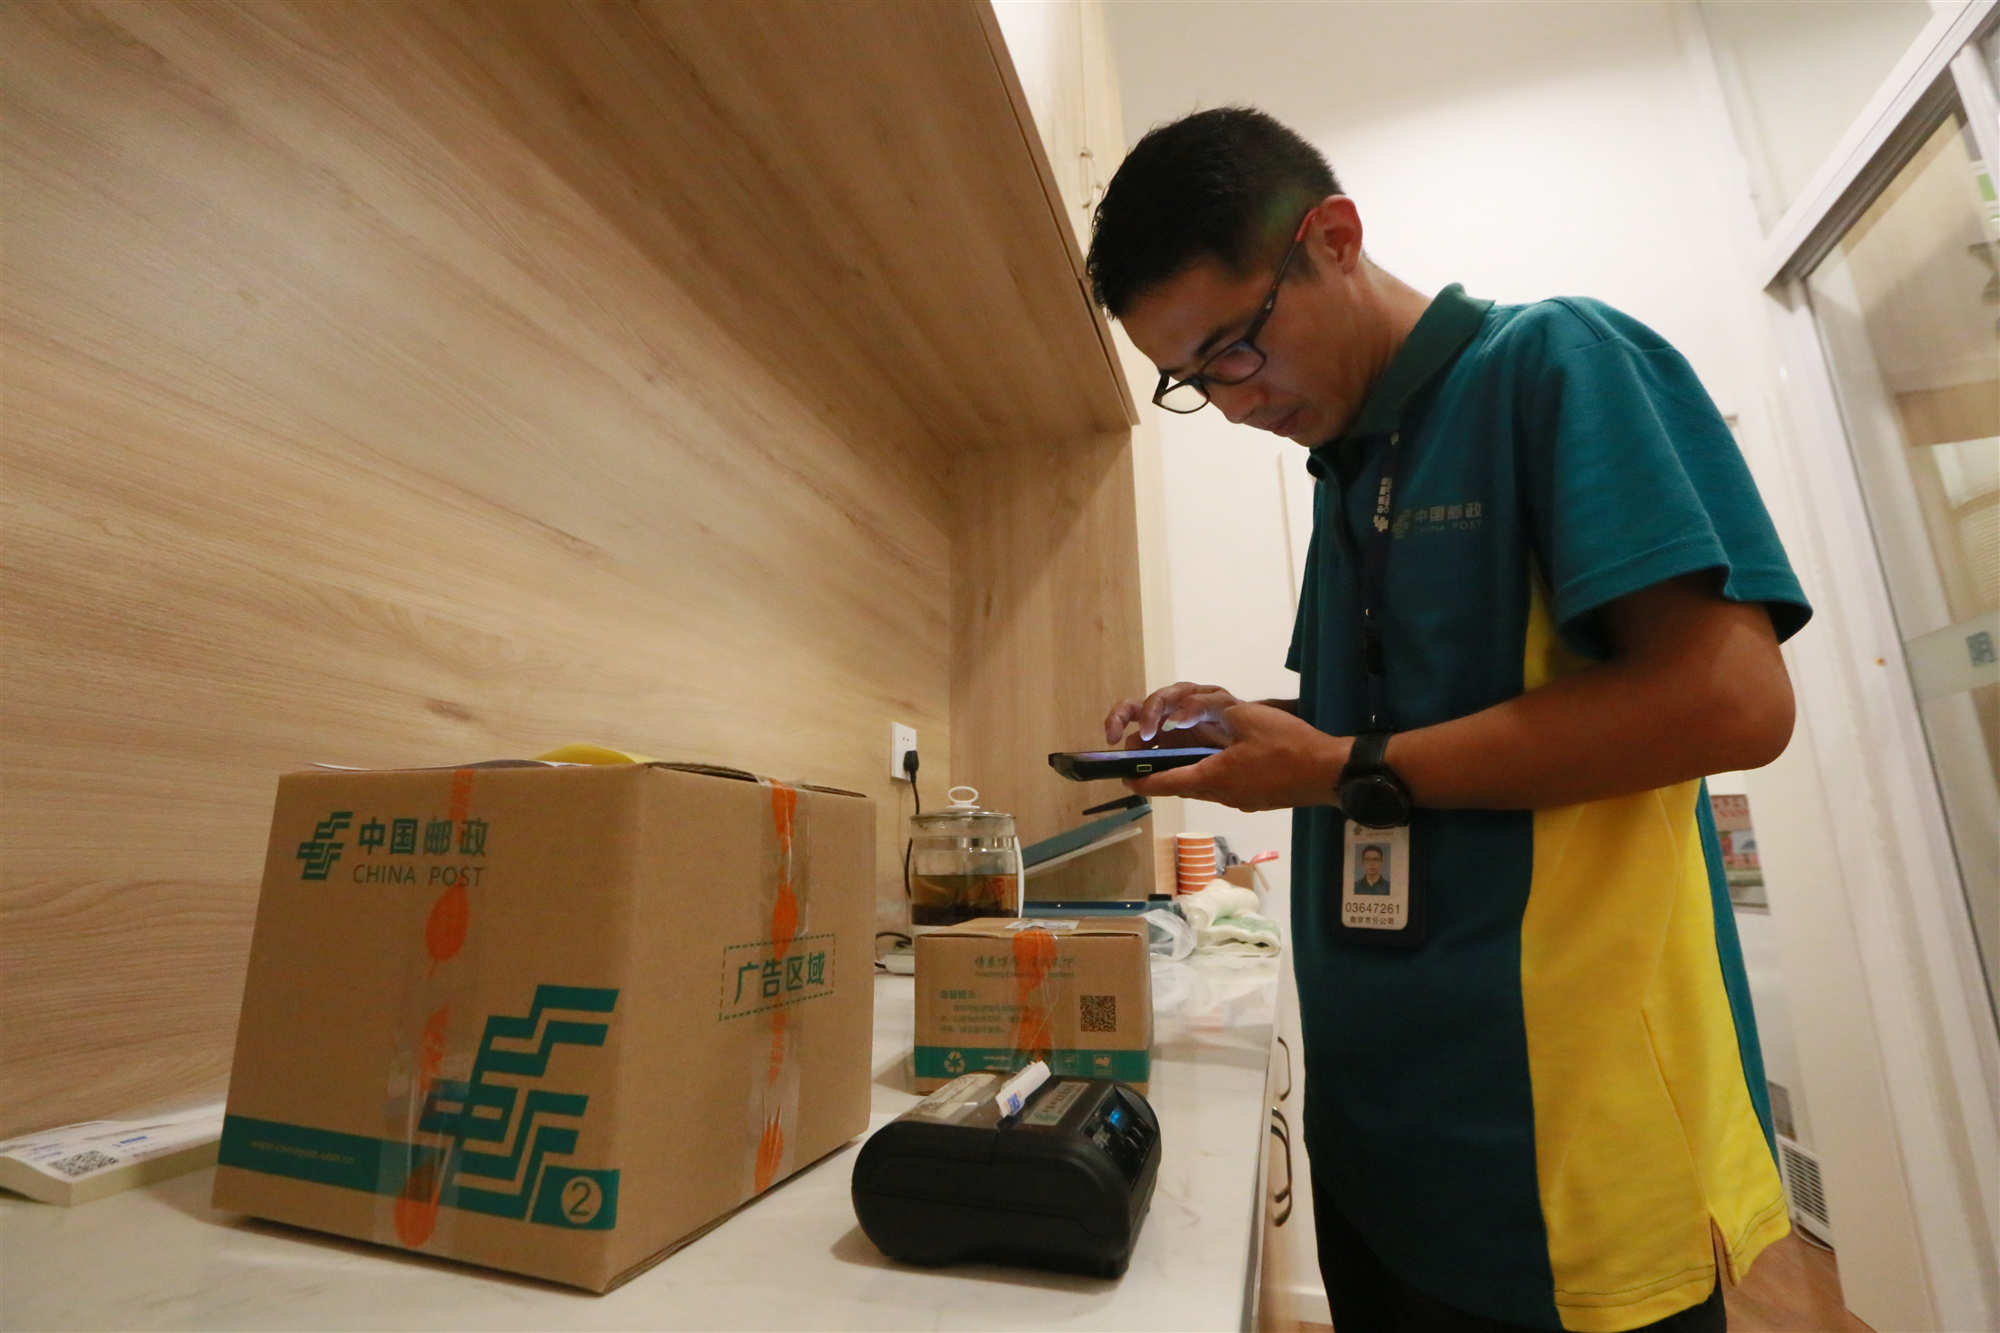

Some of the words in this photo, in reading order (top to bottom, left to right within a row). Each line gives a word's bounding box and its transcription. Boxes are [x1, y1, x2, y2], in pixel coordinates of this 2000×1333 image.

[358, 816, 489, 857] 中国邮政
[352, 864, 416, 885] CHINA
[428, 866, 486, 888] POST
[1345, 902, 1400, 914] 03647261
[733, 951, 825, 1006] 广告区域
